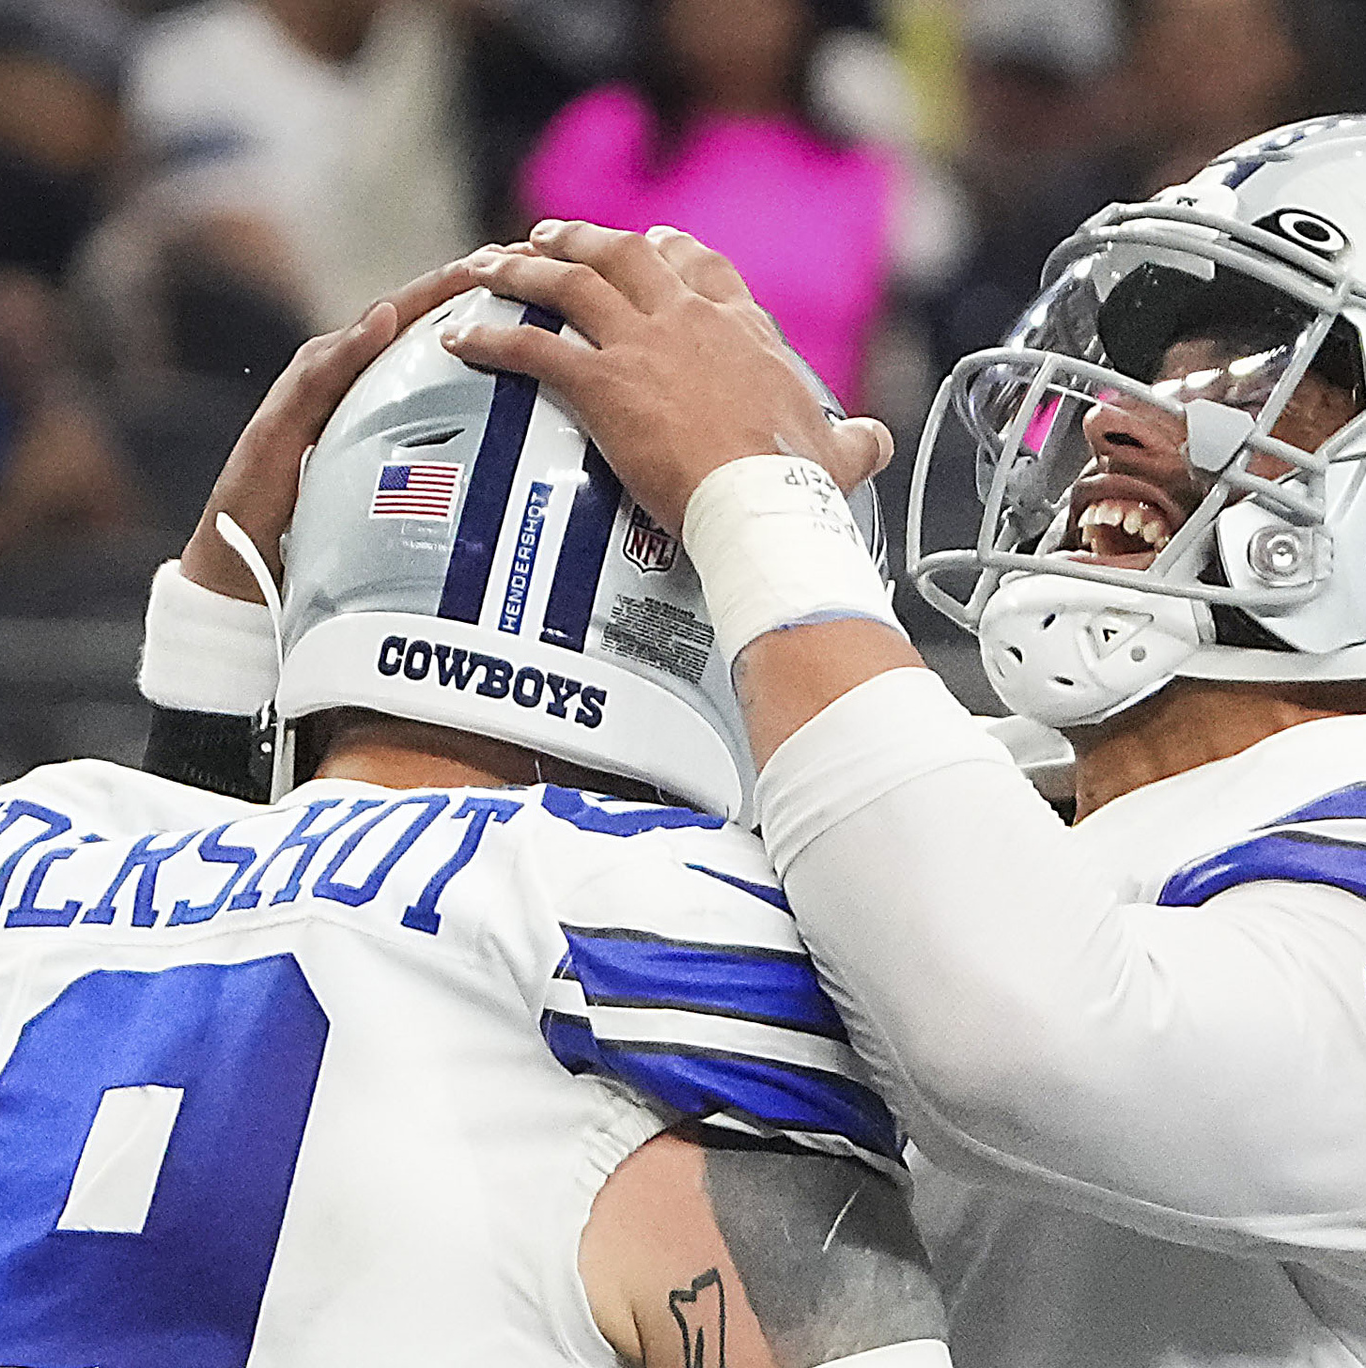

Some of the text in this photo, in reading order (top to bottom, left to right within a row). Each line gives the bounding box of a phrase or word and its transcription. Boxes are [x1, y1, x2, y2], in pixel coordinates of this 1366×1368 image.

[501, 491, 547, 632] HENDERSHOT
[628, 526, 669, 567] NFL
[376, 635, 608, 730] COWBOYS
